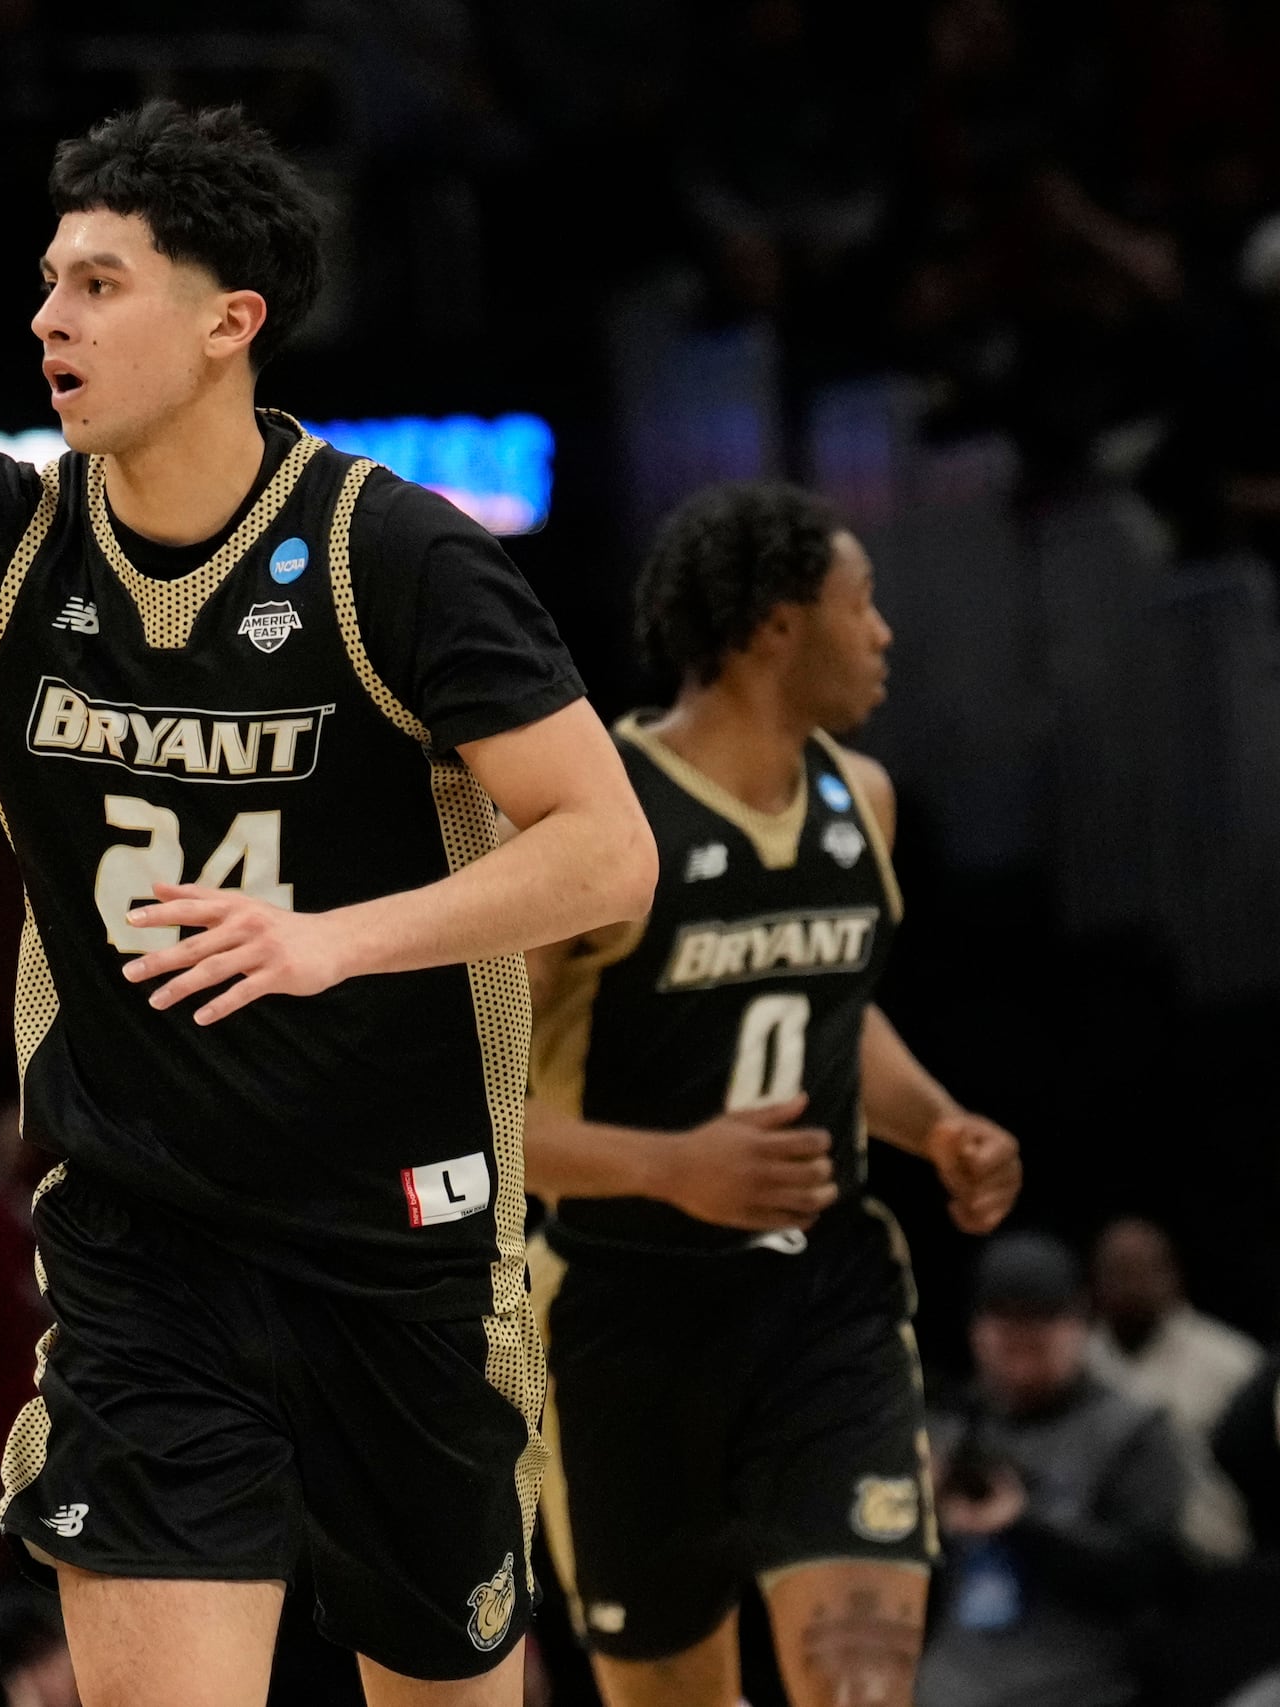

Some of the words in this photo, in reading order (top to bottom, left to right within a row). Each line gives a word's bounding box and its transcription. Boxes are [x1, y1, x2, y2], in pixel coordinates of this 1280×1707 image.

[275, 558, 305, 573] NCAA
[242, 614, 298, 632] AMERICA
[253, 626, 285, 638] EAST
[32, 685, 314, 776] BRYANT
[94, 794, 294, 954] 24
[671, 918, 869, 984] BRYANT
[725, 992, 812, 1113] 0
[442, 1171, 466, 1203] L
